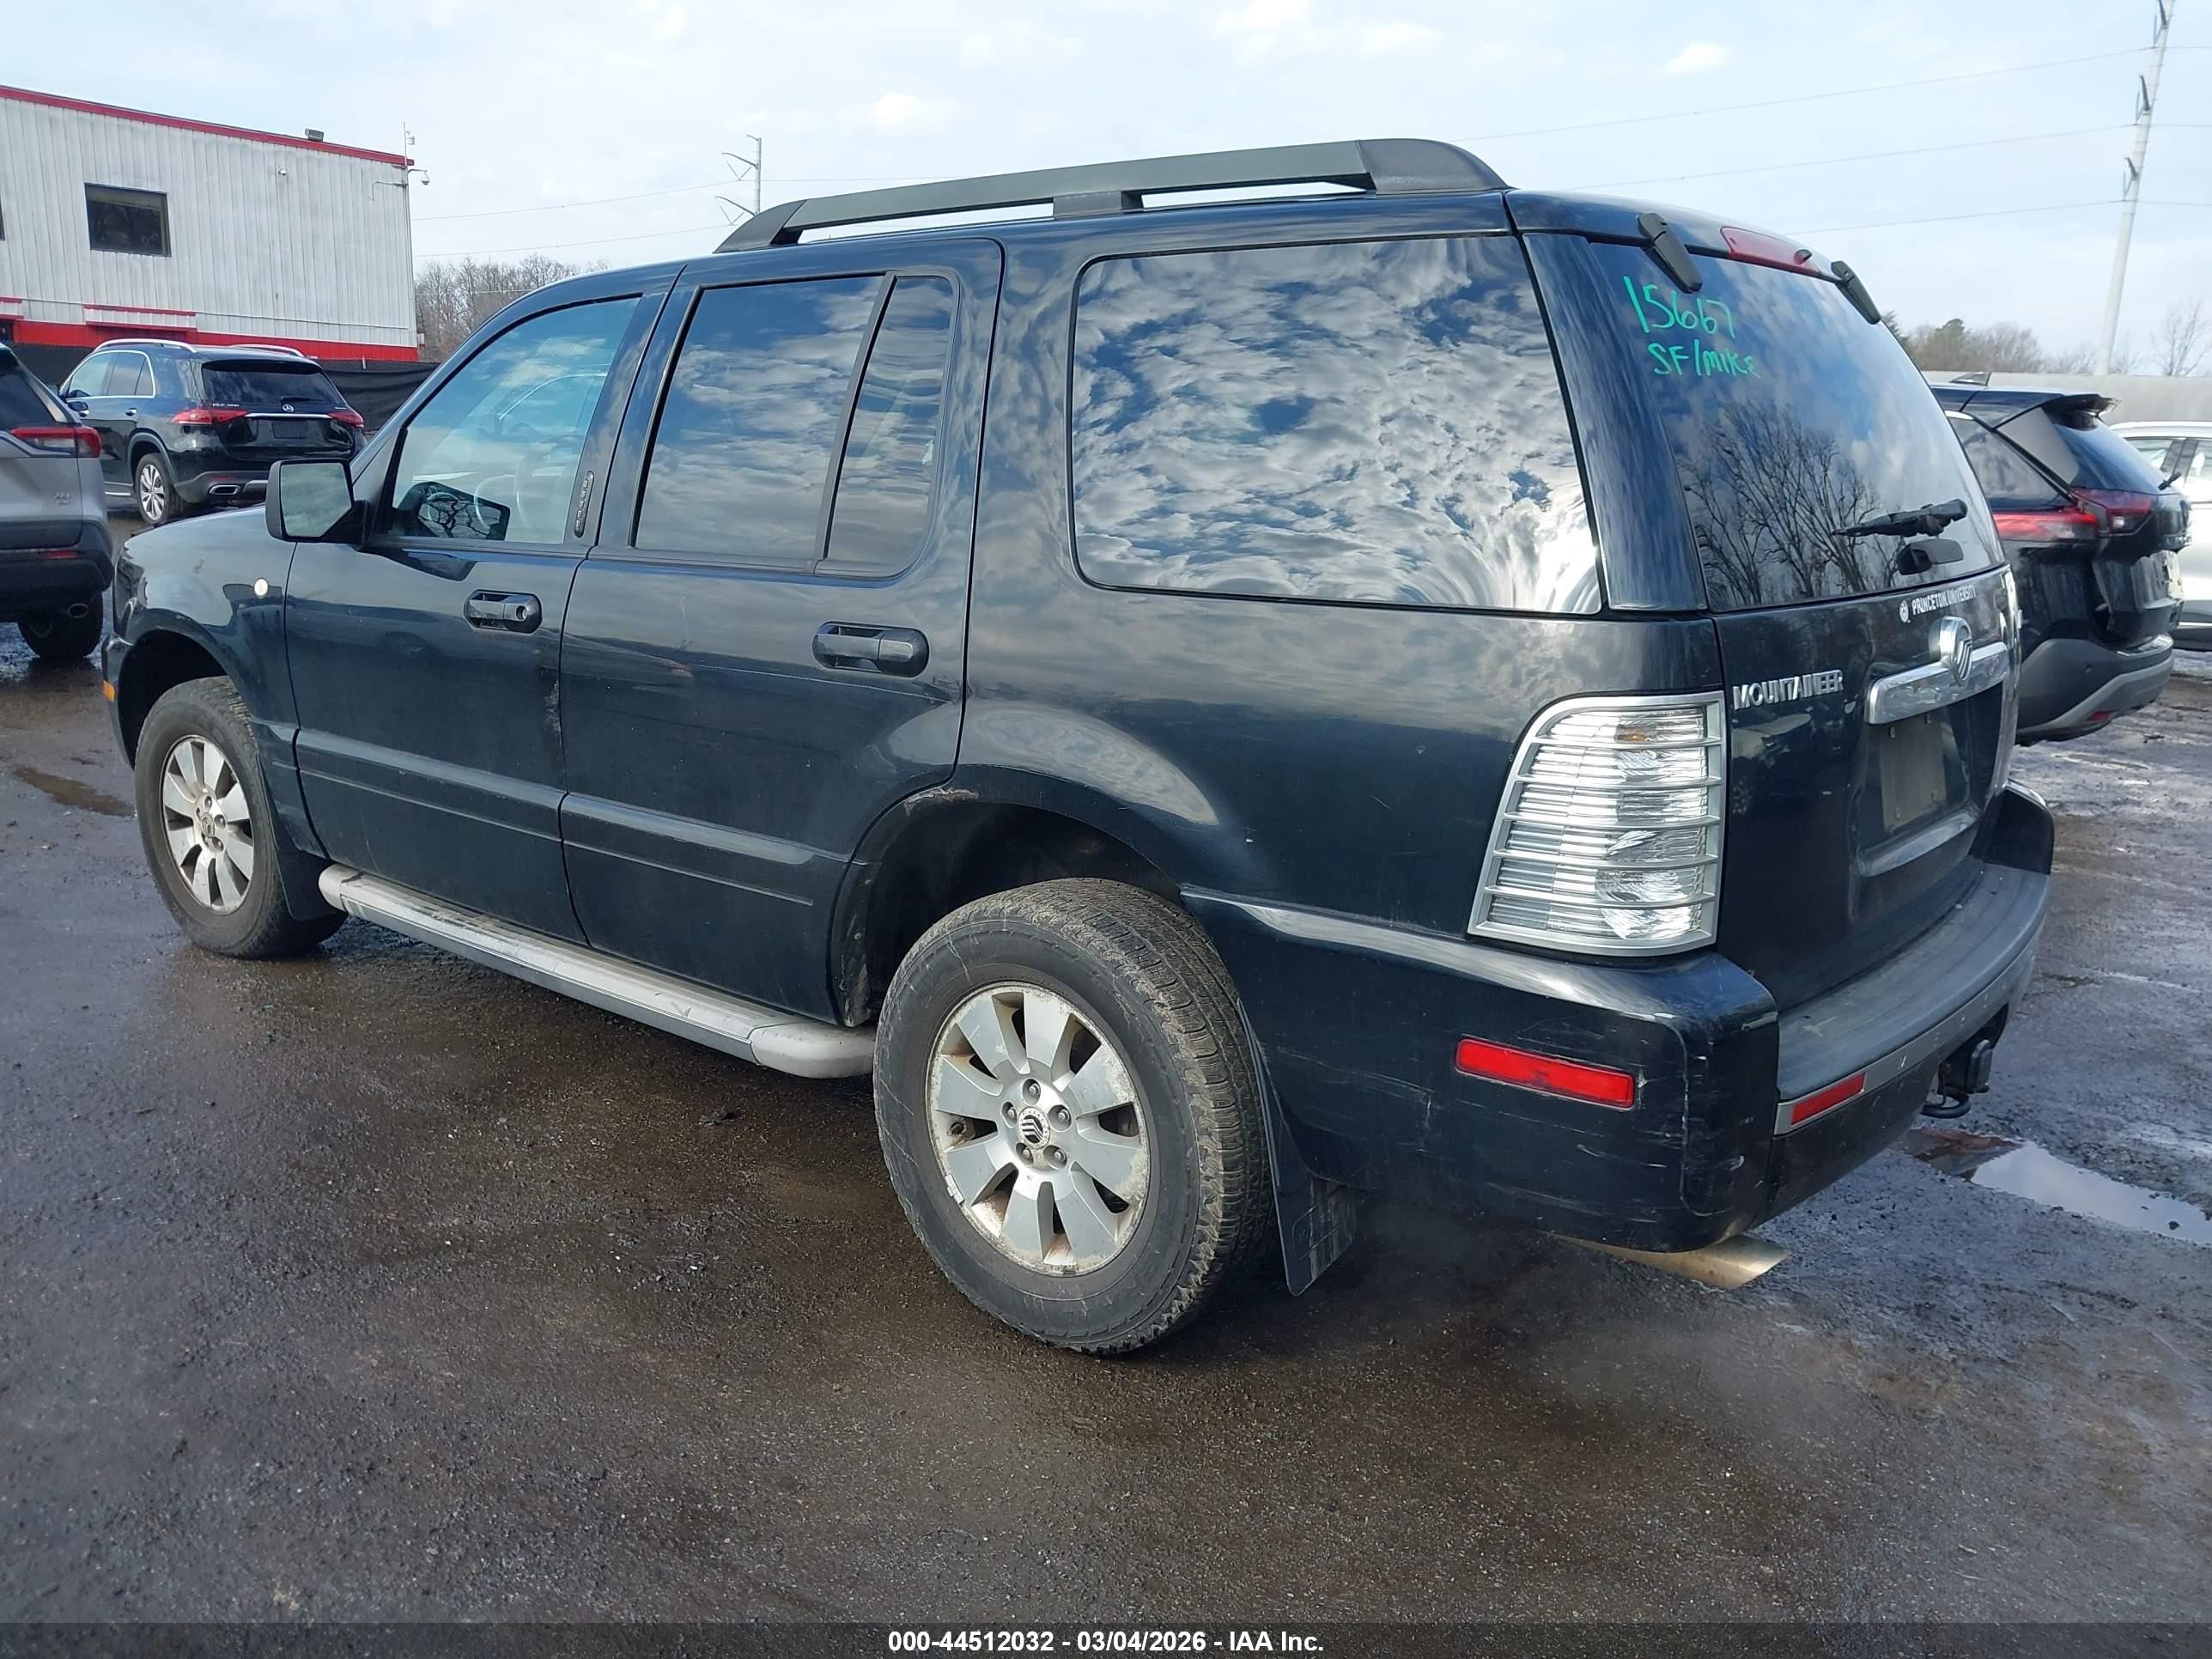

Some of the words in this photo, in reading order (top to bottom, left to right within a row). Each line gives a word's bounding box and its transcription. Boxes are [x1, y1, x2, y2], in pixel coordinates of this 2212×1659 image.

[1622, 275, 1736, 339] 15667
[1911, 592, 1948, 616] PRINCETON
[1947, 584, 1977, 605] UNIVERSITY
[1733, 670, 1844, 710] MOUNTAINEER
